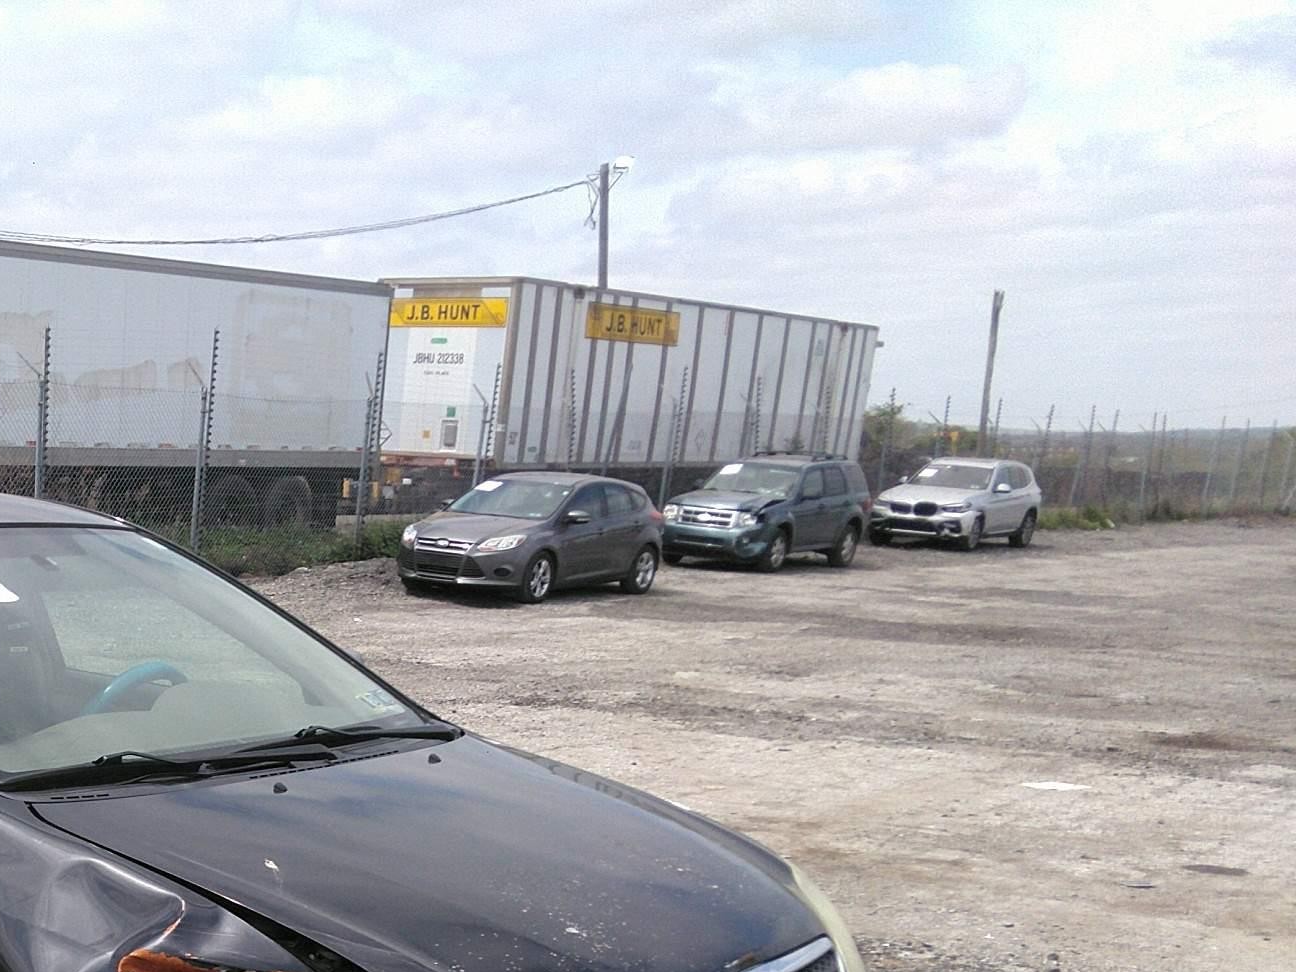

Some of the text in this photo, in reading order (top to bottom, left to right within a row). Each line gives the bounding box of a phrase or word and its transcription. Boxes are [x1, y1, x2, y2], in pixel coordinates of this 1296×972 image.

[407, 304, 481, 321] J.B. HUNT
[606, 311, 664, 337] J.B. HUNT
[413, 352, 465, 365] JBHU 212338
